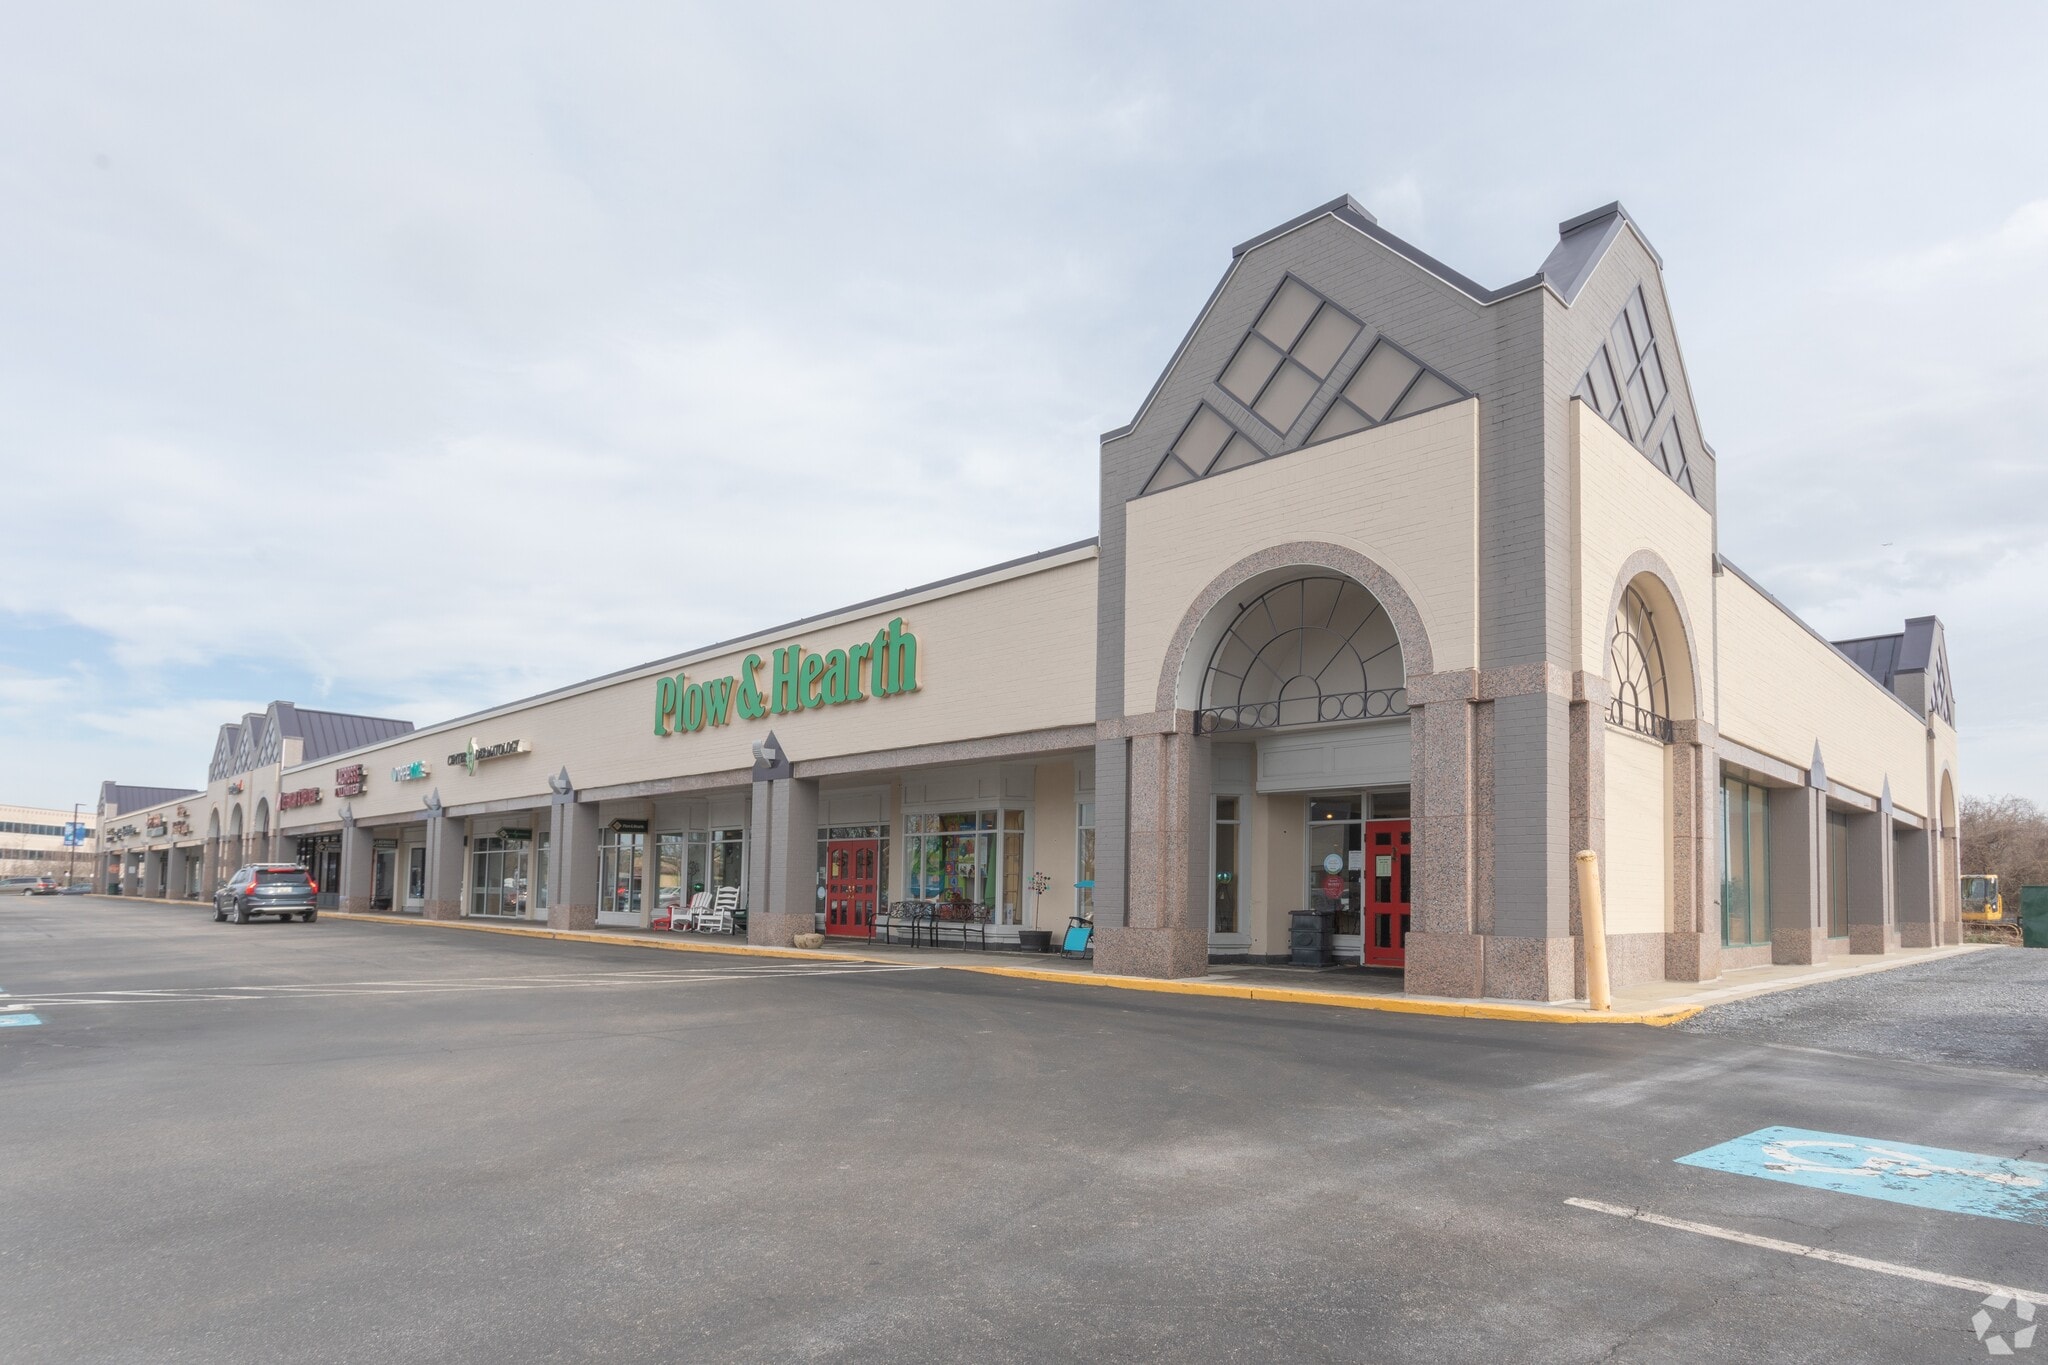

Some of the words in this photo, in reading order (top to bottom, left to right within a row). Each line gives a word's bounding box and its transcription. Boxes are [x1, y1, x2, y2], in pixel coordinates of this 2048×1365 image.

[654, 672, 735, 736] Plow
[736, 653, 766, 720] &
[770, 616, 920, 715] Hearth
[475, 739, 521, 760] DERMATOLOGY
